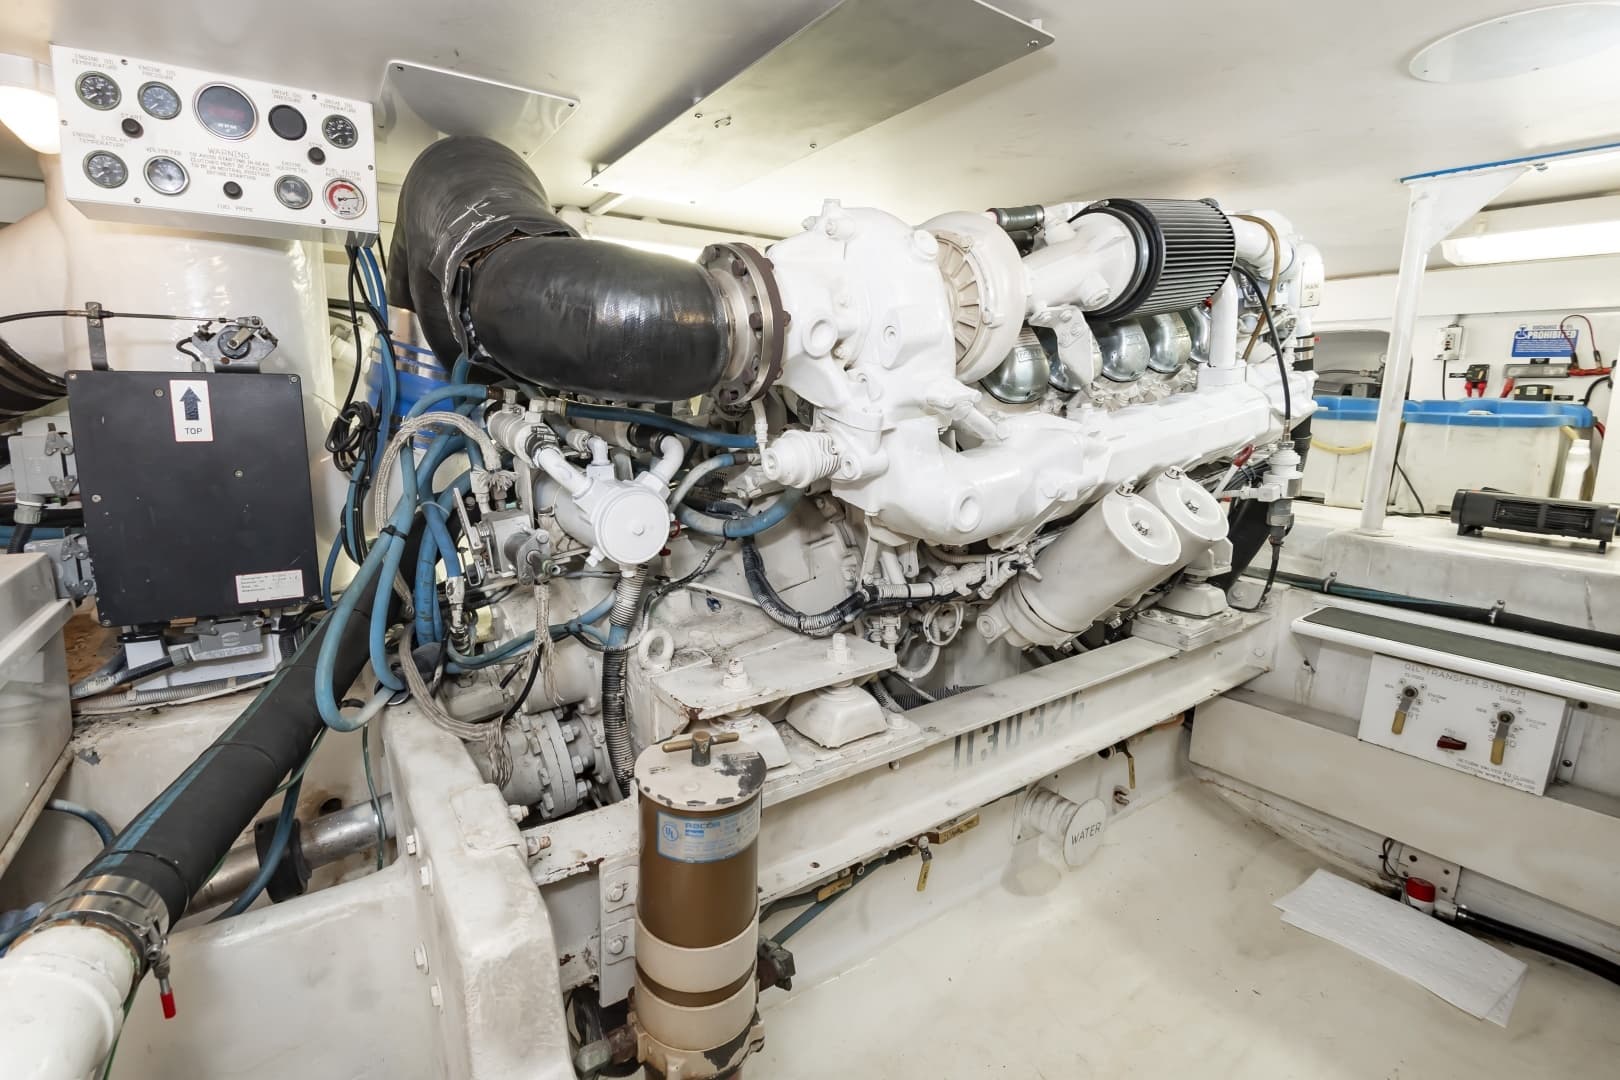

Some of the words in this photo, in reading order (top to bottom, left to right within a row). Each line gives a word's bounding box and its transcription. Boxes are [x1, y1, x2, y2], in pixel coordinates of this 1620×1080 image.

[208, 146, 250, 160] WARNING
[184, 427, 203, 435] TOP
[1404, 663, 1422, 673] OIL
[1426, 668, 1478, 686] TRANSFER
[1482, 683, 1527, 697] SYSTEM
[1071, 822, 1102, 846] WATER
